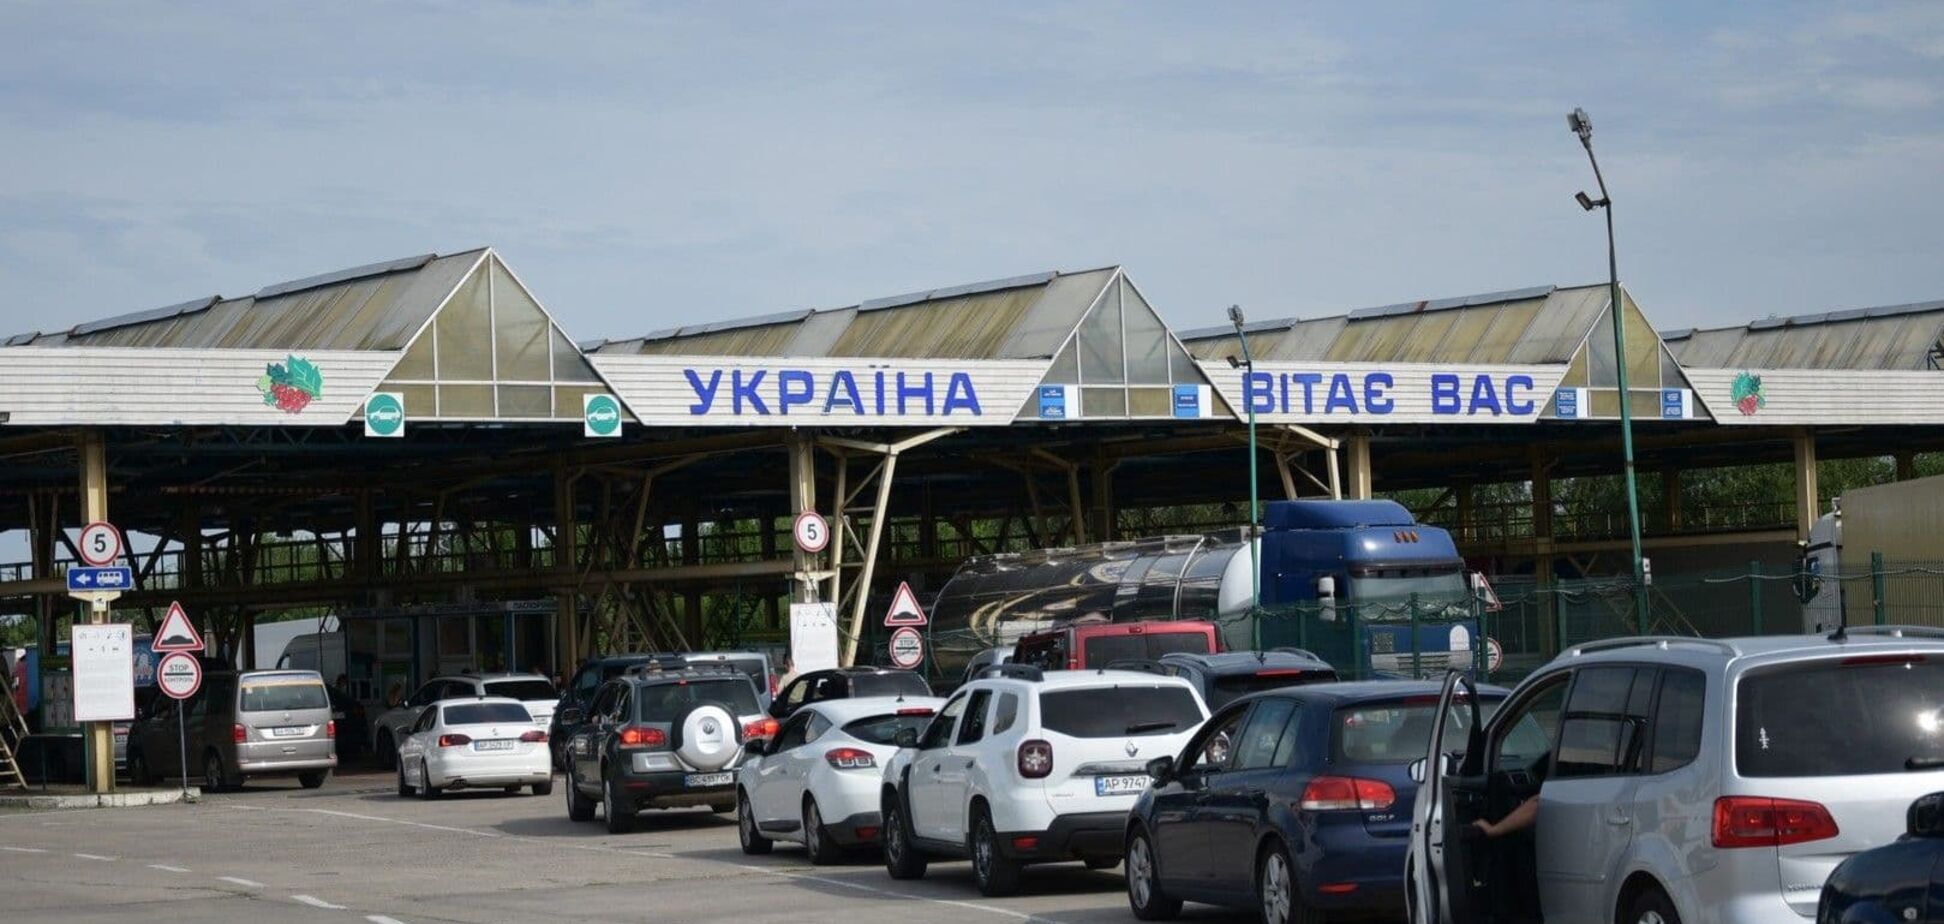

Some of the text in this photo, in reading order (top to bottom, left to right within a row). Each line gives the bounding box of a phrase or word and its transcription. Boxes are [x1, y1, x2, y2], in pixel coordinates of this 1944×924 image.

[684, 364, 982, 416] УКРАЇНА
[1242, 372, 1535, 416] ВІТАЄ ВАС
[807, 523, 817, 541] 5
[94, 533, 107, 553] 5
[1105, 778, 1119, 789] AP
[1122, 777, 1147, 788] 9747
